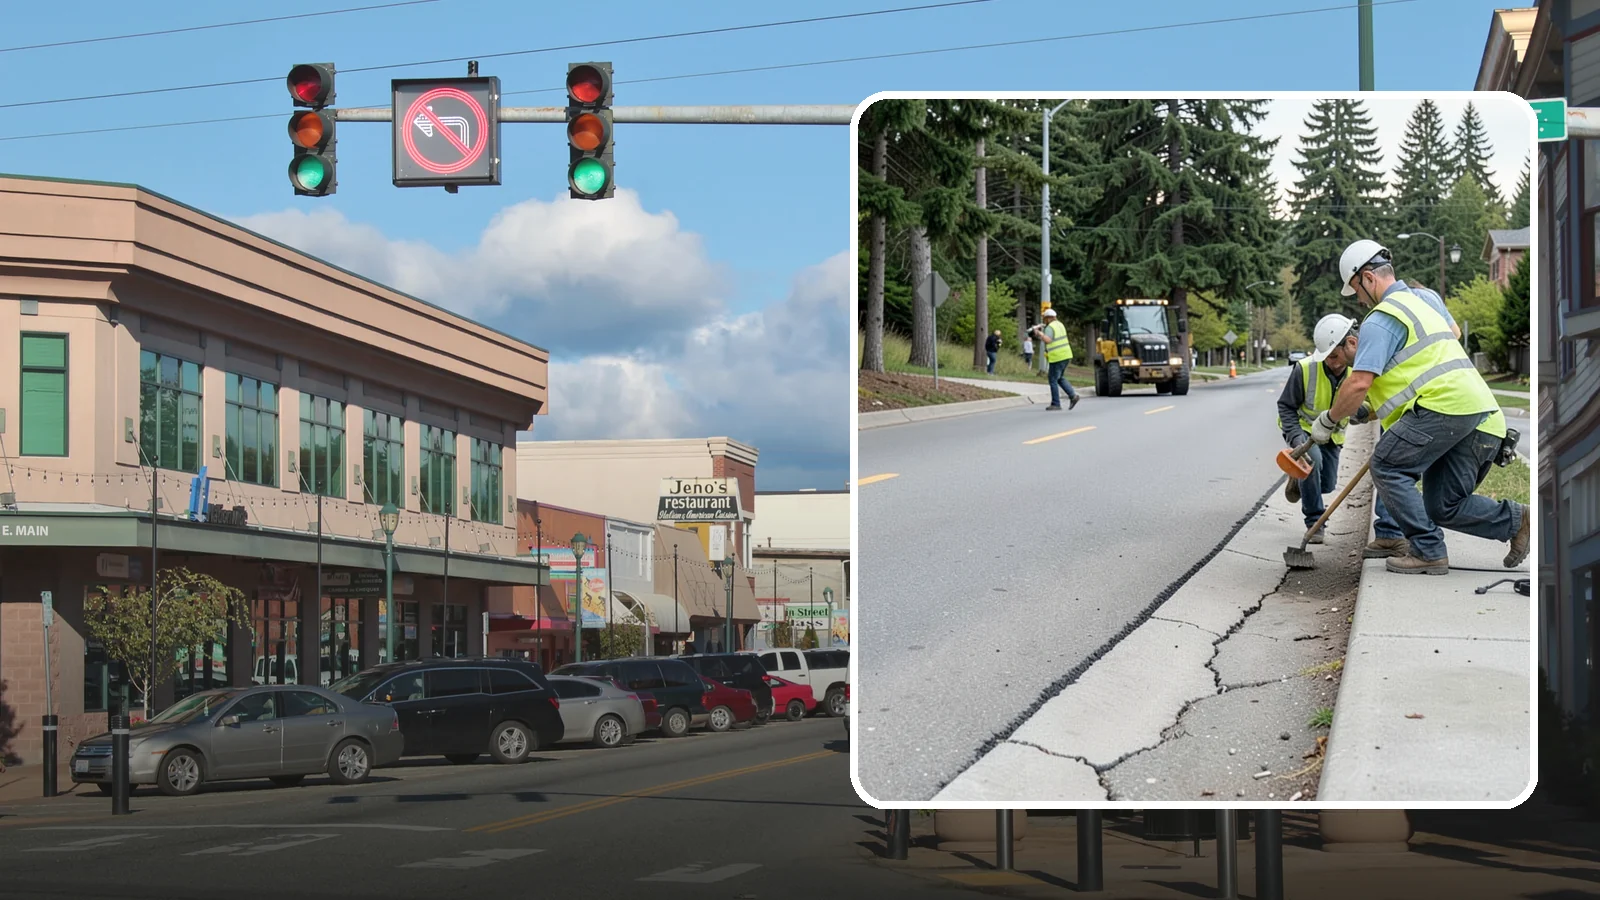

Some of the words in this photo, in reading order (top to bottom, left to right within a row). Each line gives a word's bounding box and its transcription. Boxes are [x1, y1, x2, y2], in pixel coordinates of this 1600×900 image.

[670, 480, 727, 494] Jeno's
[665, 496, 731, 509] restaurant
[659, 510, 681, 519] Italian
[686, 510, 714, 519] American
[715, 509, 737, 519] Cuisine
[2, 525, 13, 536] E.
[15, 525, 49, 536] MAIN
[797, 608, 828, 616] Street
[791, 619, 823, 627] lass
